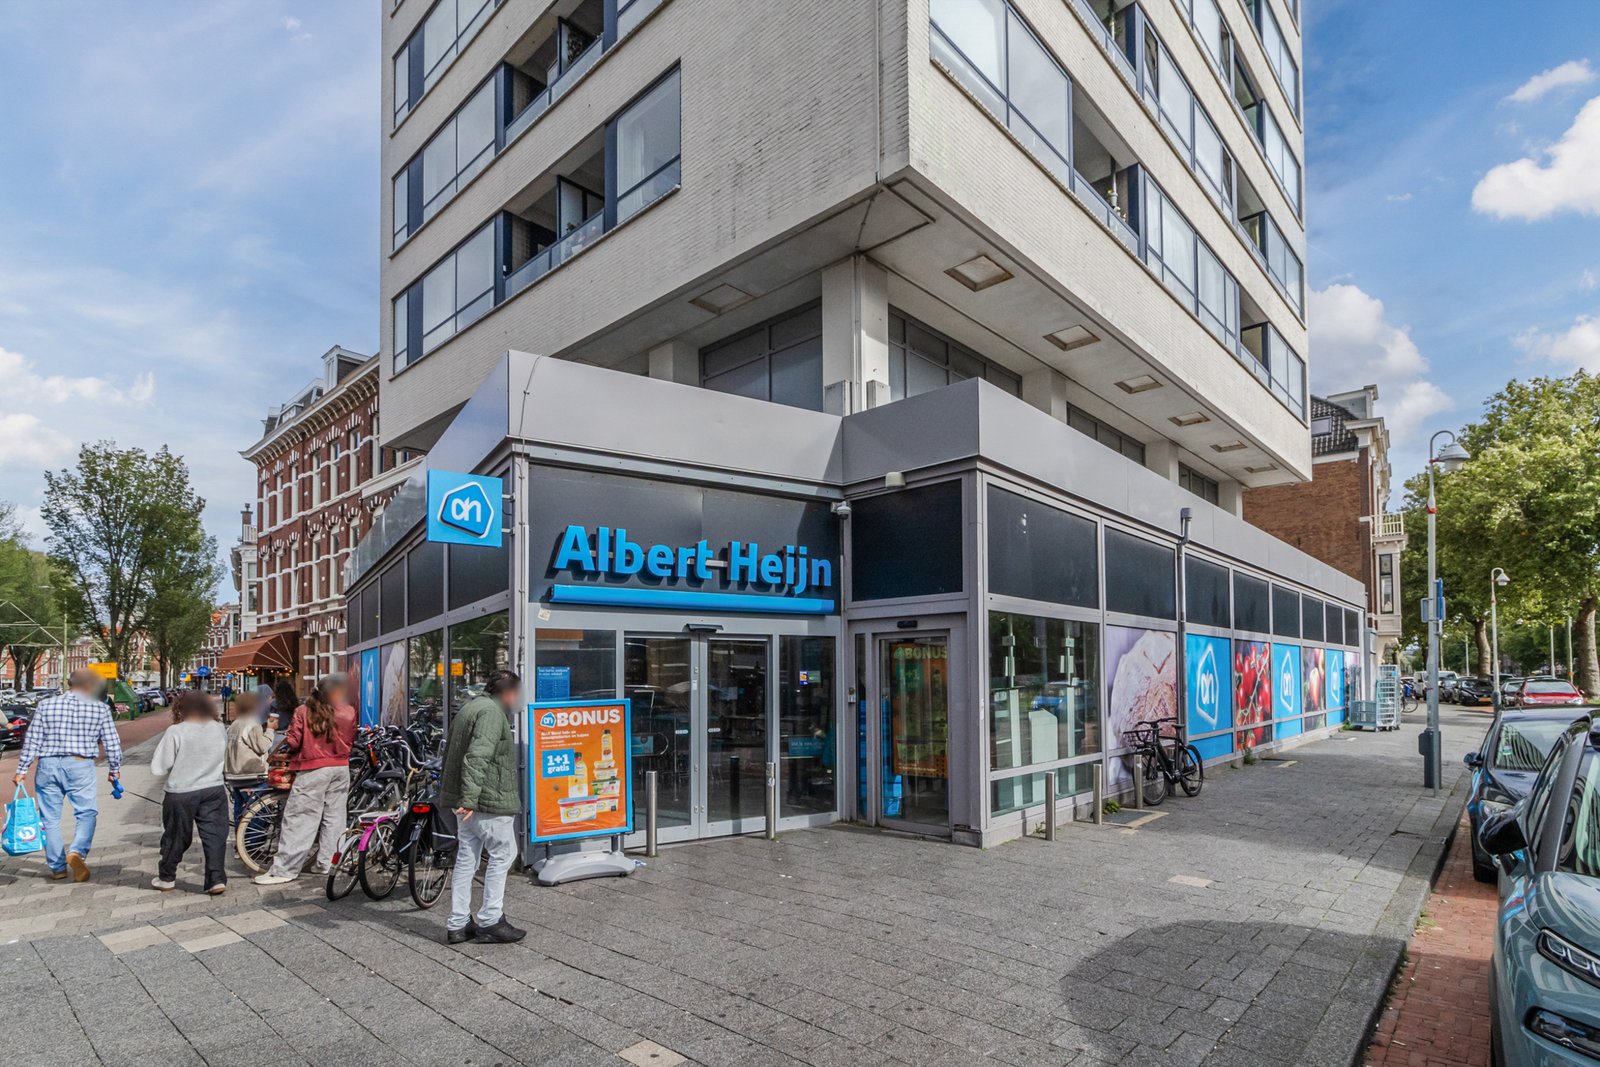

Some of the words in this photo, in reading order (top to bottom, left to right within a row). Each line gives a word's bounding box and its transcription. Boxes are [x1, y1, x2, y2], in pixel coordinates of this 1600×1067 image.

[553, 525, 714, 580] Albert
[727, 540, 832, 595] Heijn
[905, 646, 947, 659] BONUS
[556, 709, 620, 727] BONUS
[547, 754, 570, 766] 1+1
[547, 764, 570, 774] gratis
